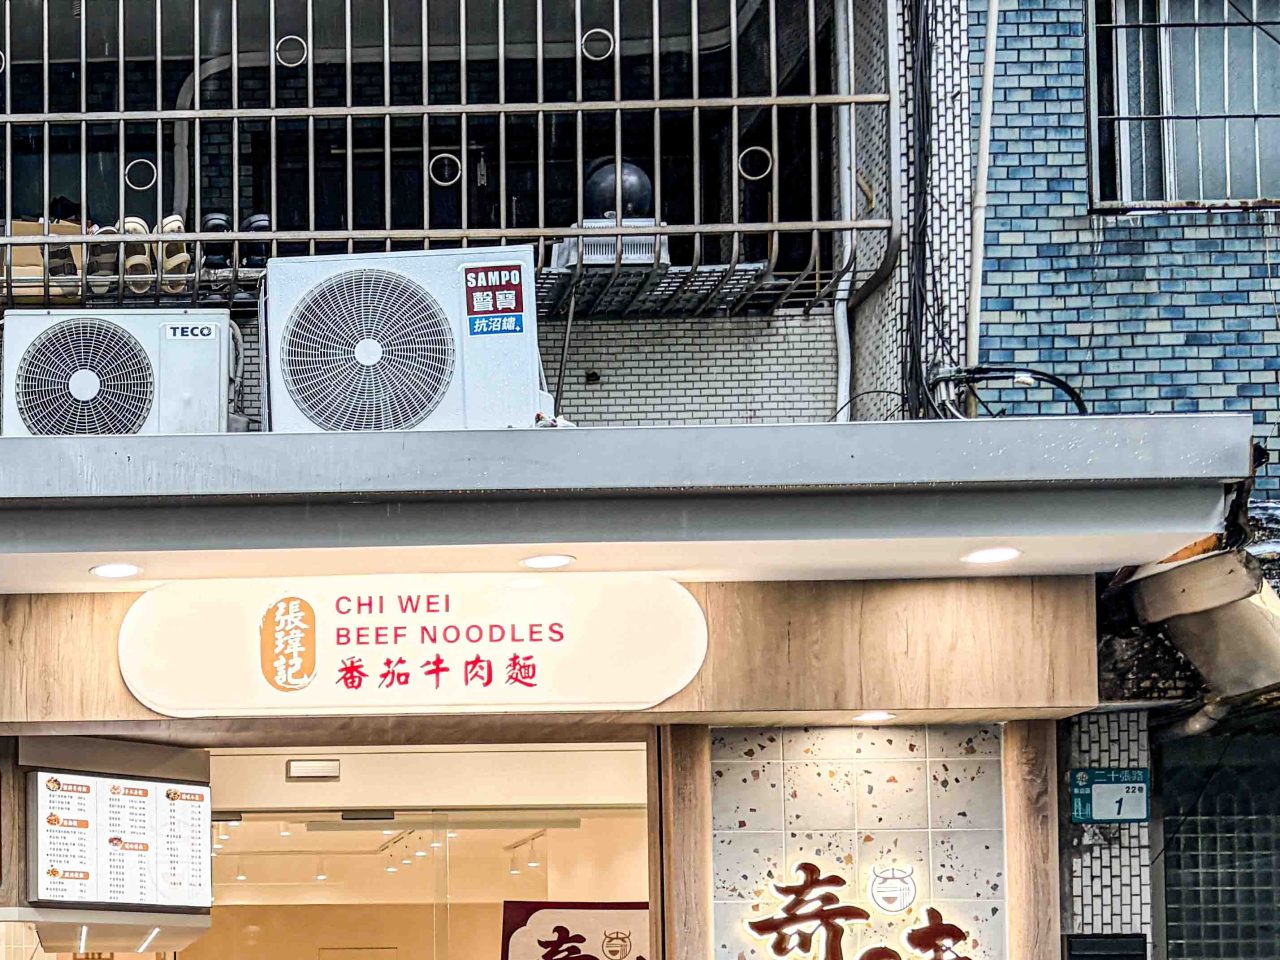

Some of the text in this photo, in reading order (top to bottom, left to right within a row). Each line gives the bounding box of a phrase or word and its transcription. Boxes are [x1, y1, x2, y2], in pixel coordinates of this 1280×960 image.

[467, 270, 520, 287] SAMPO
[472, 290, 517, 311] 聲寶
[169, 325, 212, 337] TECO
[335, 594, 450, 614] CHI WEI
[335, 622, 566, 645] BEEF NOODLES
[334, 653, 539, 689] 番茄牛肉麵
[1115, 797, 1124, 816] 1
